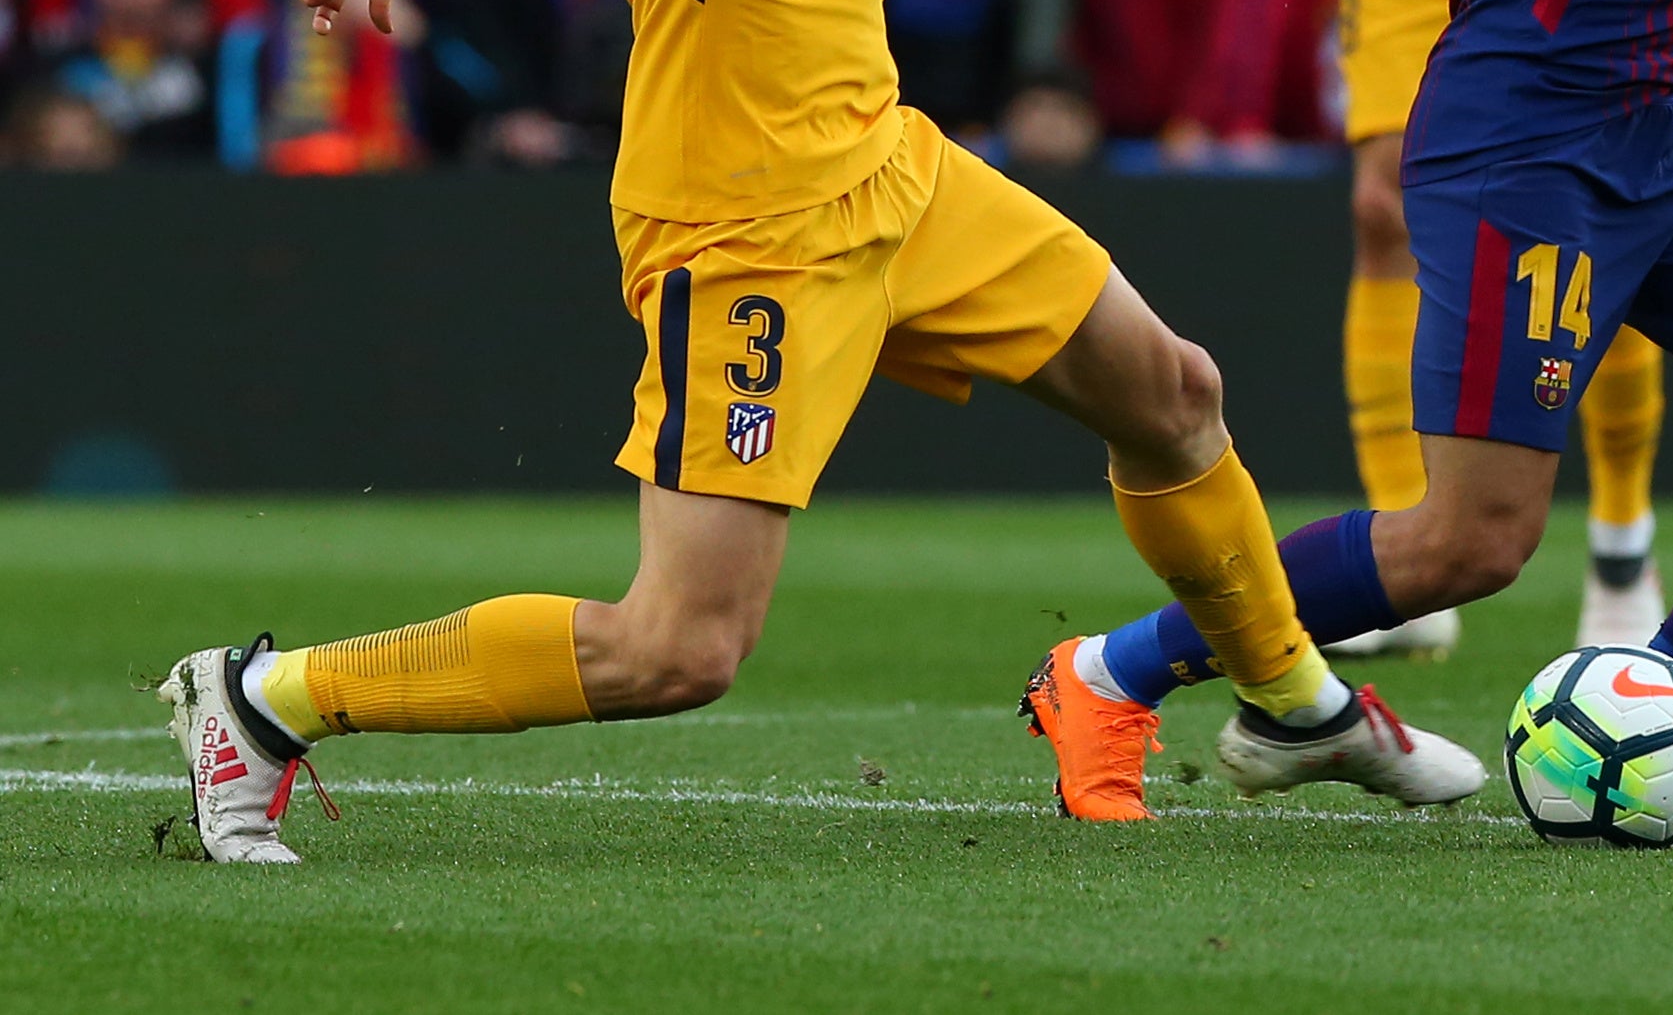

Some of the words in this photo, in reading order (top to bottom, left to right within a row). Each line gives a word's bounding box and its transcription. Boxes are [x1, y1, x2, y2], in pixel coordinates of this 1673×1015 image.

[725, 295, 785, 398] 3
[1516, 243, 1592, 351] 14
[198, 716, 218, 799] adidas
